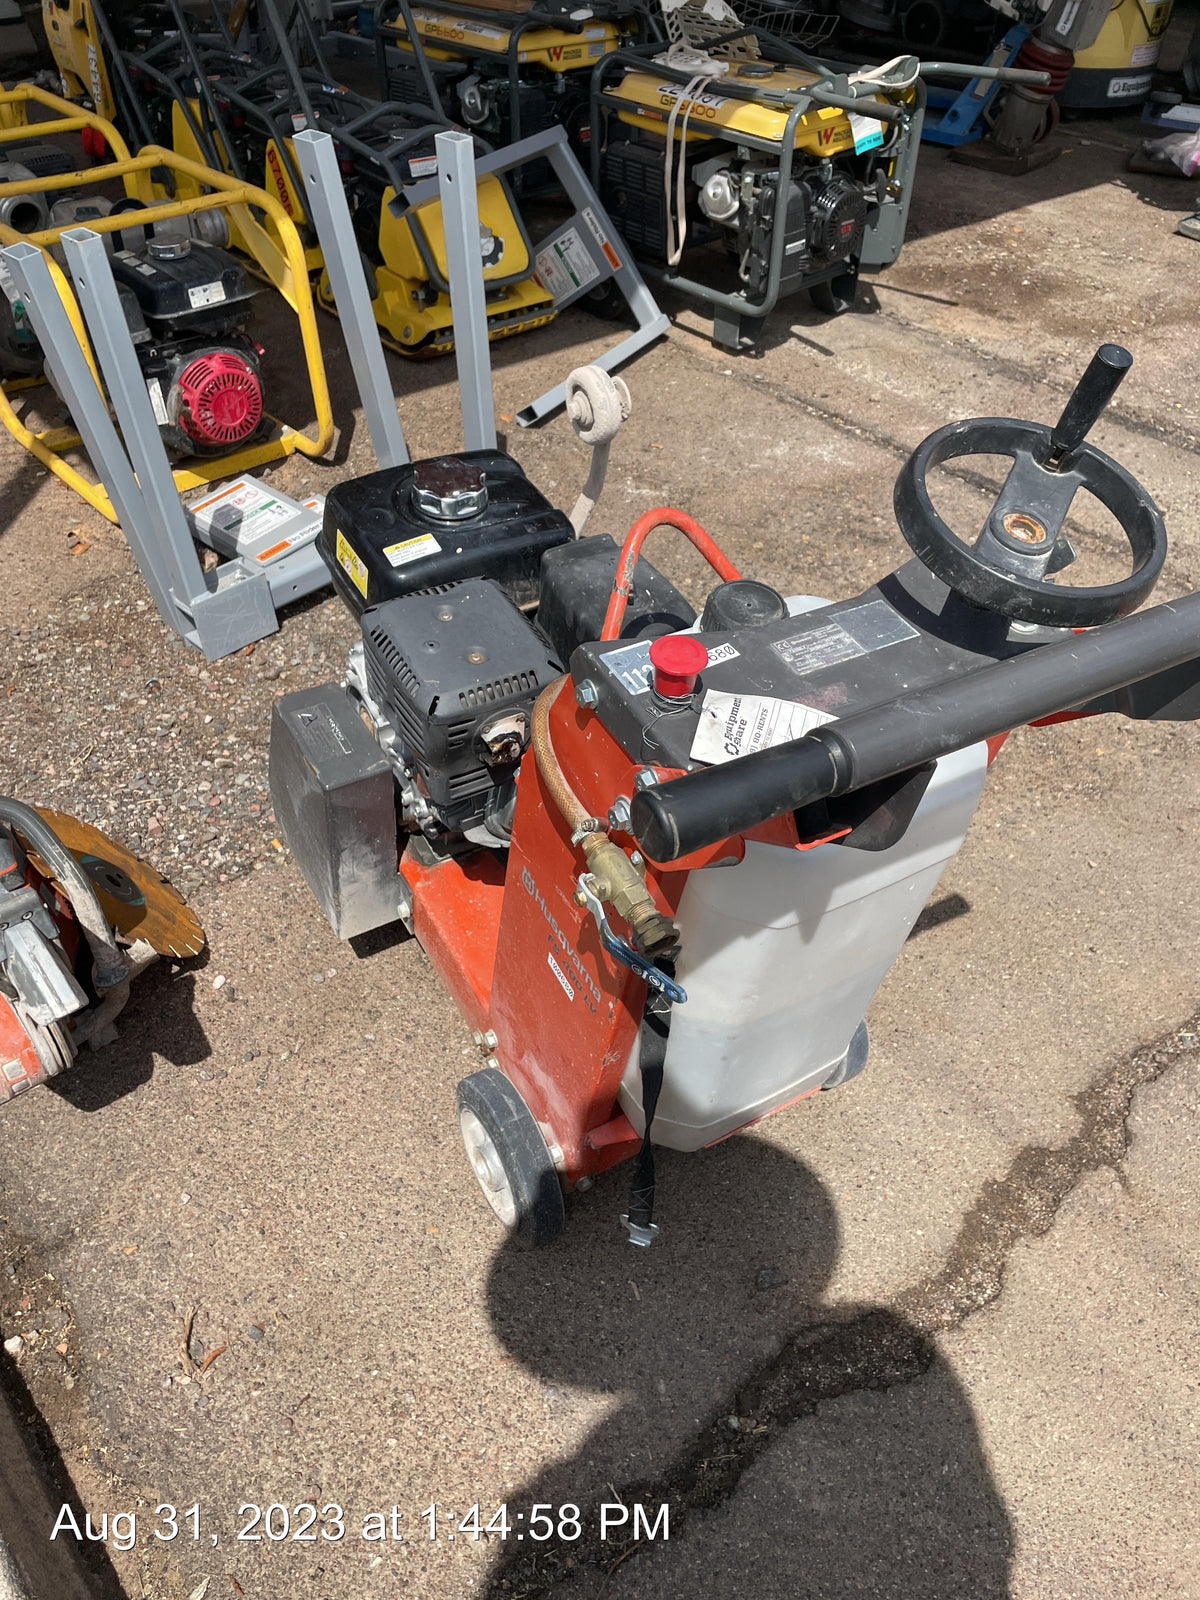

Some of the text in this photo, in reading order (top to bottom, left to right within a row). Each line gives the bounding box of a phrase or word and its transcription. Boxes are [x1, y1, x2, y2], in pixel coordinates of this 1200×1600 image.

[424, 23, 465, 40] GP6600
[724, 697, 742, 741] Equipmen
[534, 888, 602, 1003] Husqvarna
[562, 960, 584, 991] 400
